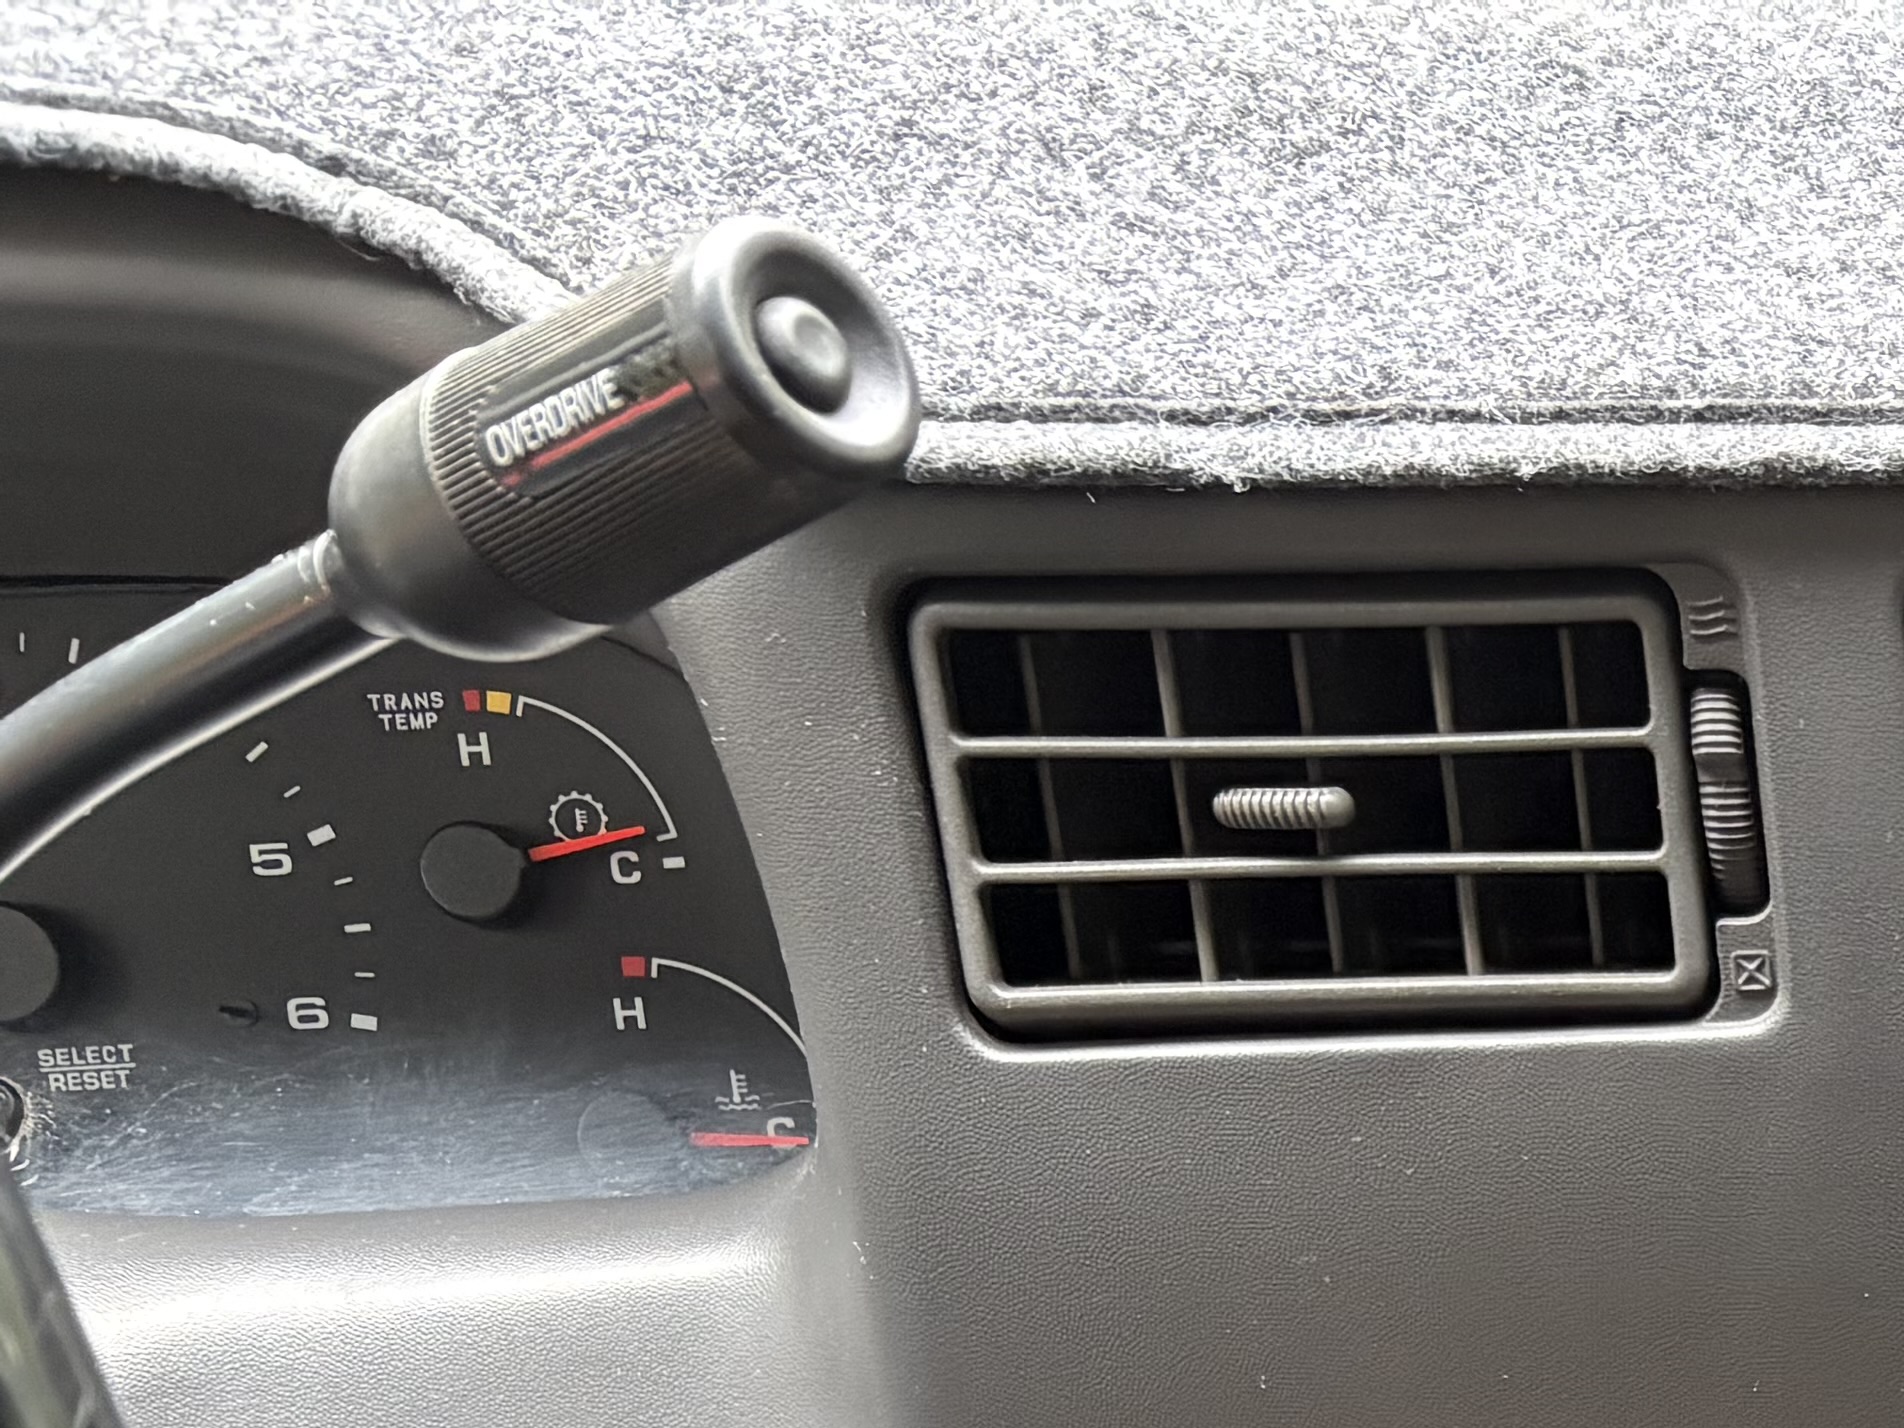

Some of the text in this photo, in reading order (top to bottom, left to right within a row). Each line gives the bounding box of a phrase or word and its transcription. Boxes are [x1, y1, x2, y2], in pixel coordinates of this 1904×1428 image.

[485, 366, 626, 467] OVERDRIVE
[366, 691, 444, 711] TRANS
[378, 711, 438, 731] TEMP
[457, 731, 492, 767] H
[249, 842, 293, 876] 5
[610, 850, 642, 884] C
[286, 996, 329, 1030] 6
[612, 996, 647, 1031] H
[37, 1043, 134, 1067] SELECT
[48, 1069, 130, 1092] RESET
